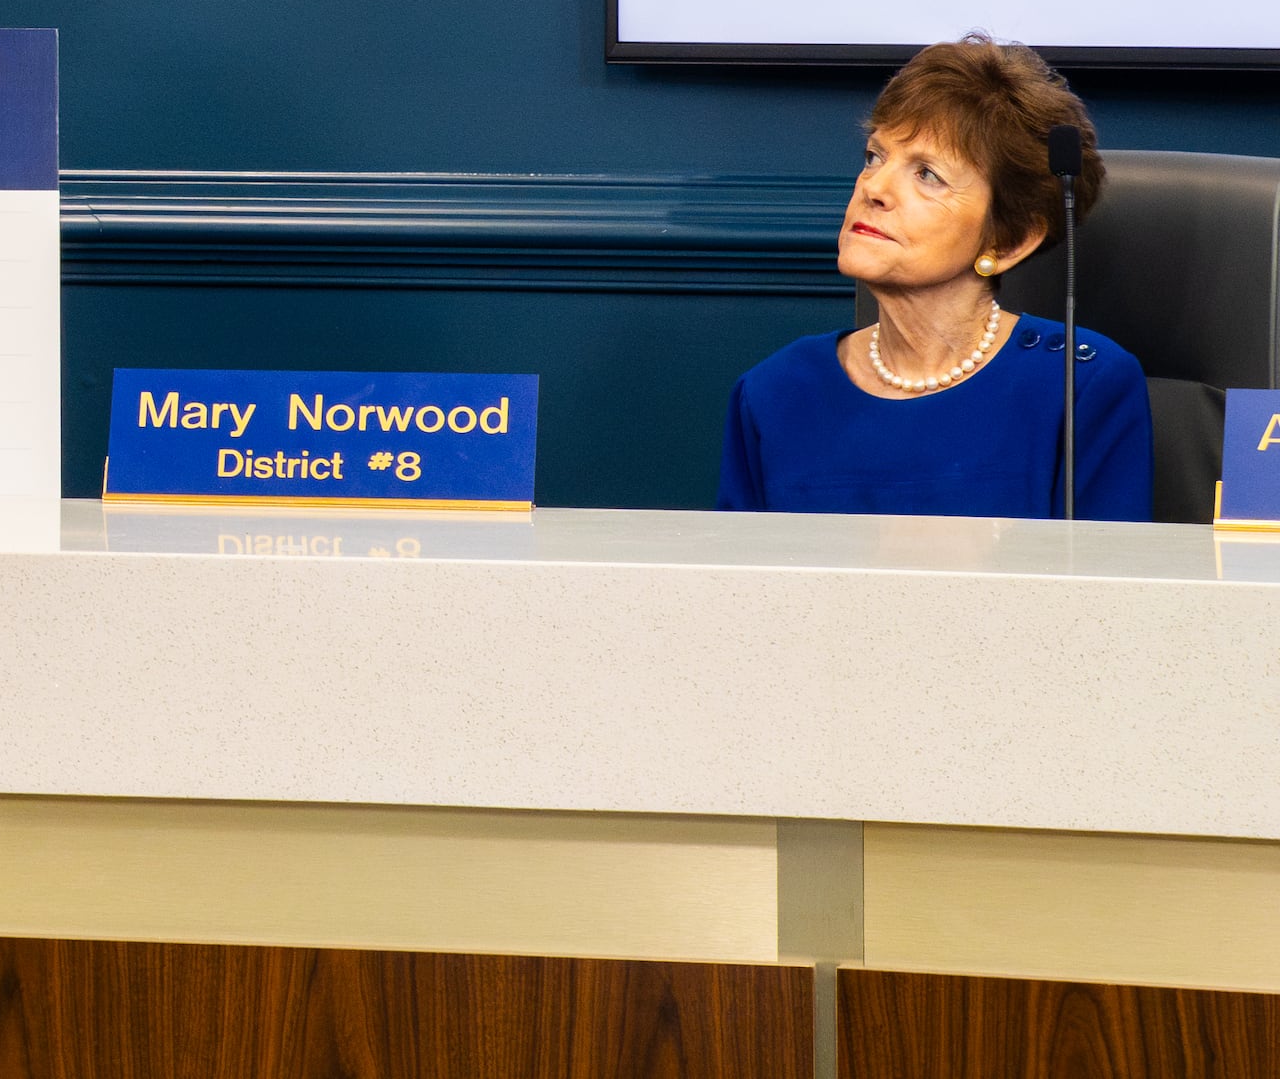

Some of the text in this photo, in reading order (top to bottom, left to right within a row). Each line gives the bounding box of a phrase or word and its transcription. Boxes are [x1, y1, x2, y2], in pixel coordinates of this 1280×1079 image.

[138, 391, 509, 437] Mary Norwood
[217, 449, 422, 481] District #8
